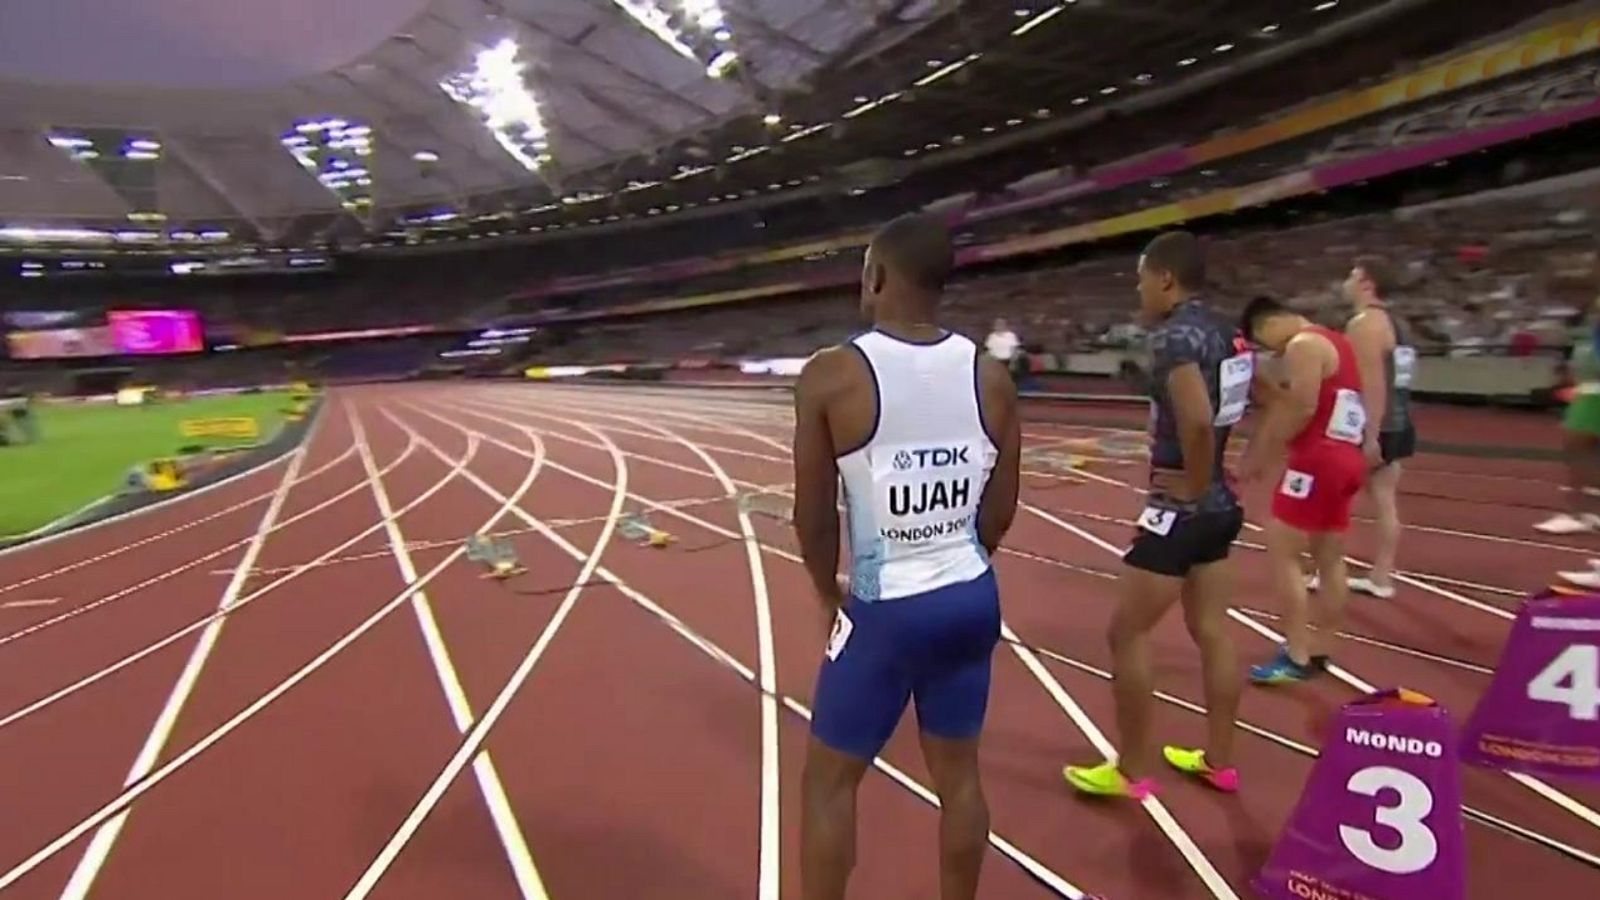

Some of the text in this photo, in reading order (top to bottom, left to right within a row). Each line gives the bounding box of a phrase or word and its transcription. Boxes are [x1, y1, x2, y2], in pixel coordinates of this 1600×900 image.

[912, 446, 968, 468] TDK
[889, 477, 970, 517] UJAH
[1147, 510, 1165, 526] 3
[1527, 644, 1600, 721] 4
[1346, 727, 1442, 757] MONDO
[1339, 766, 1438, 874] 3
